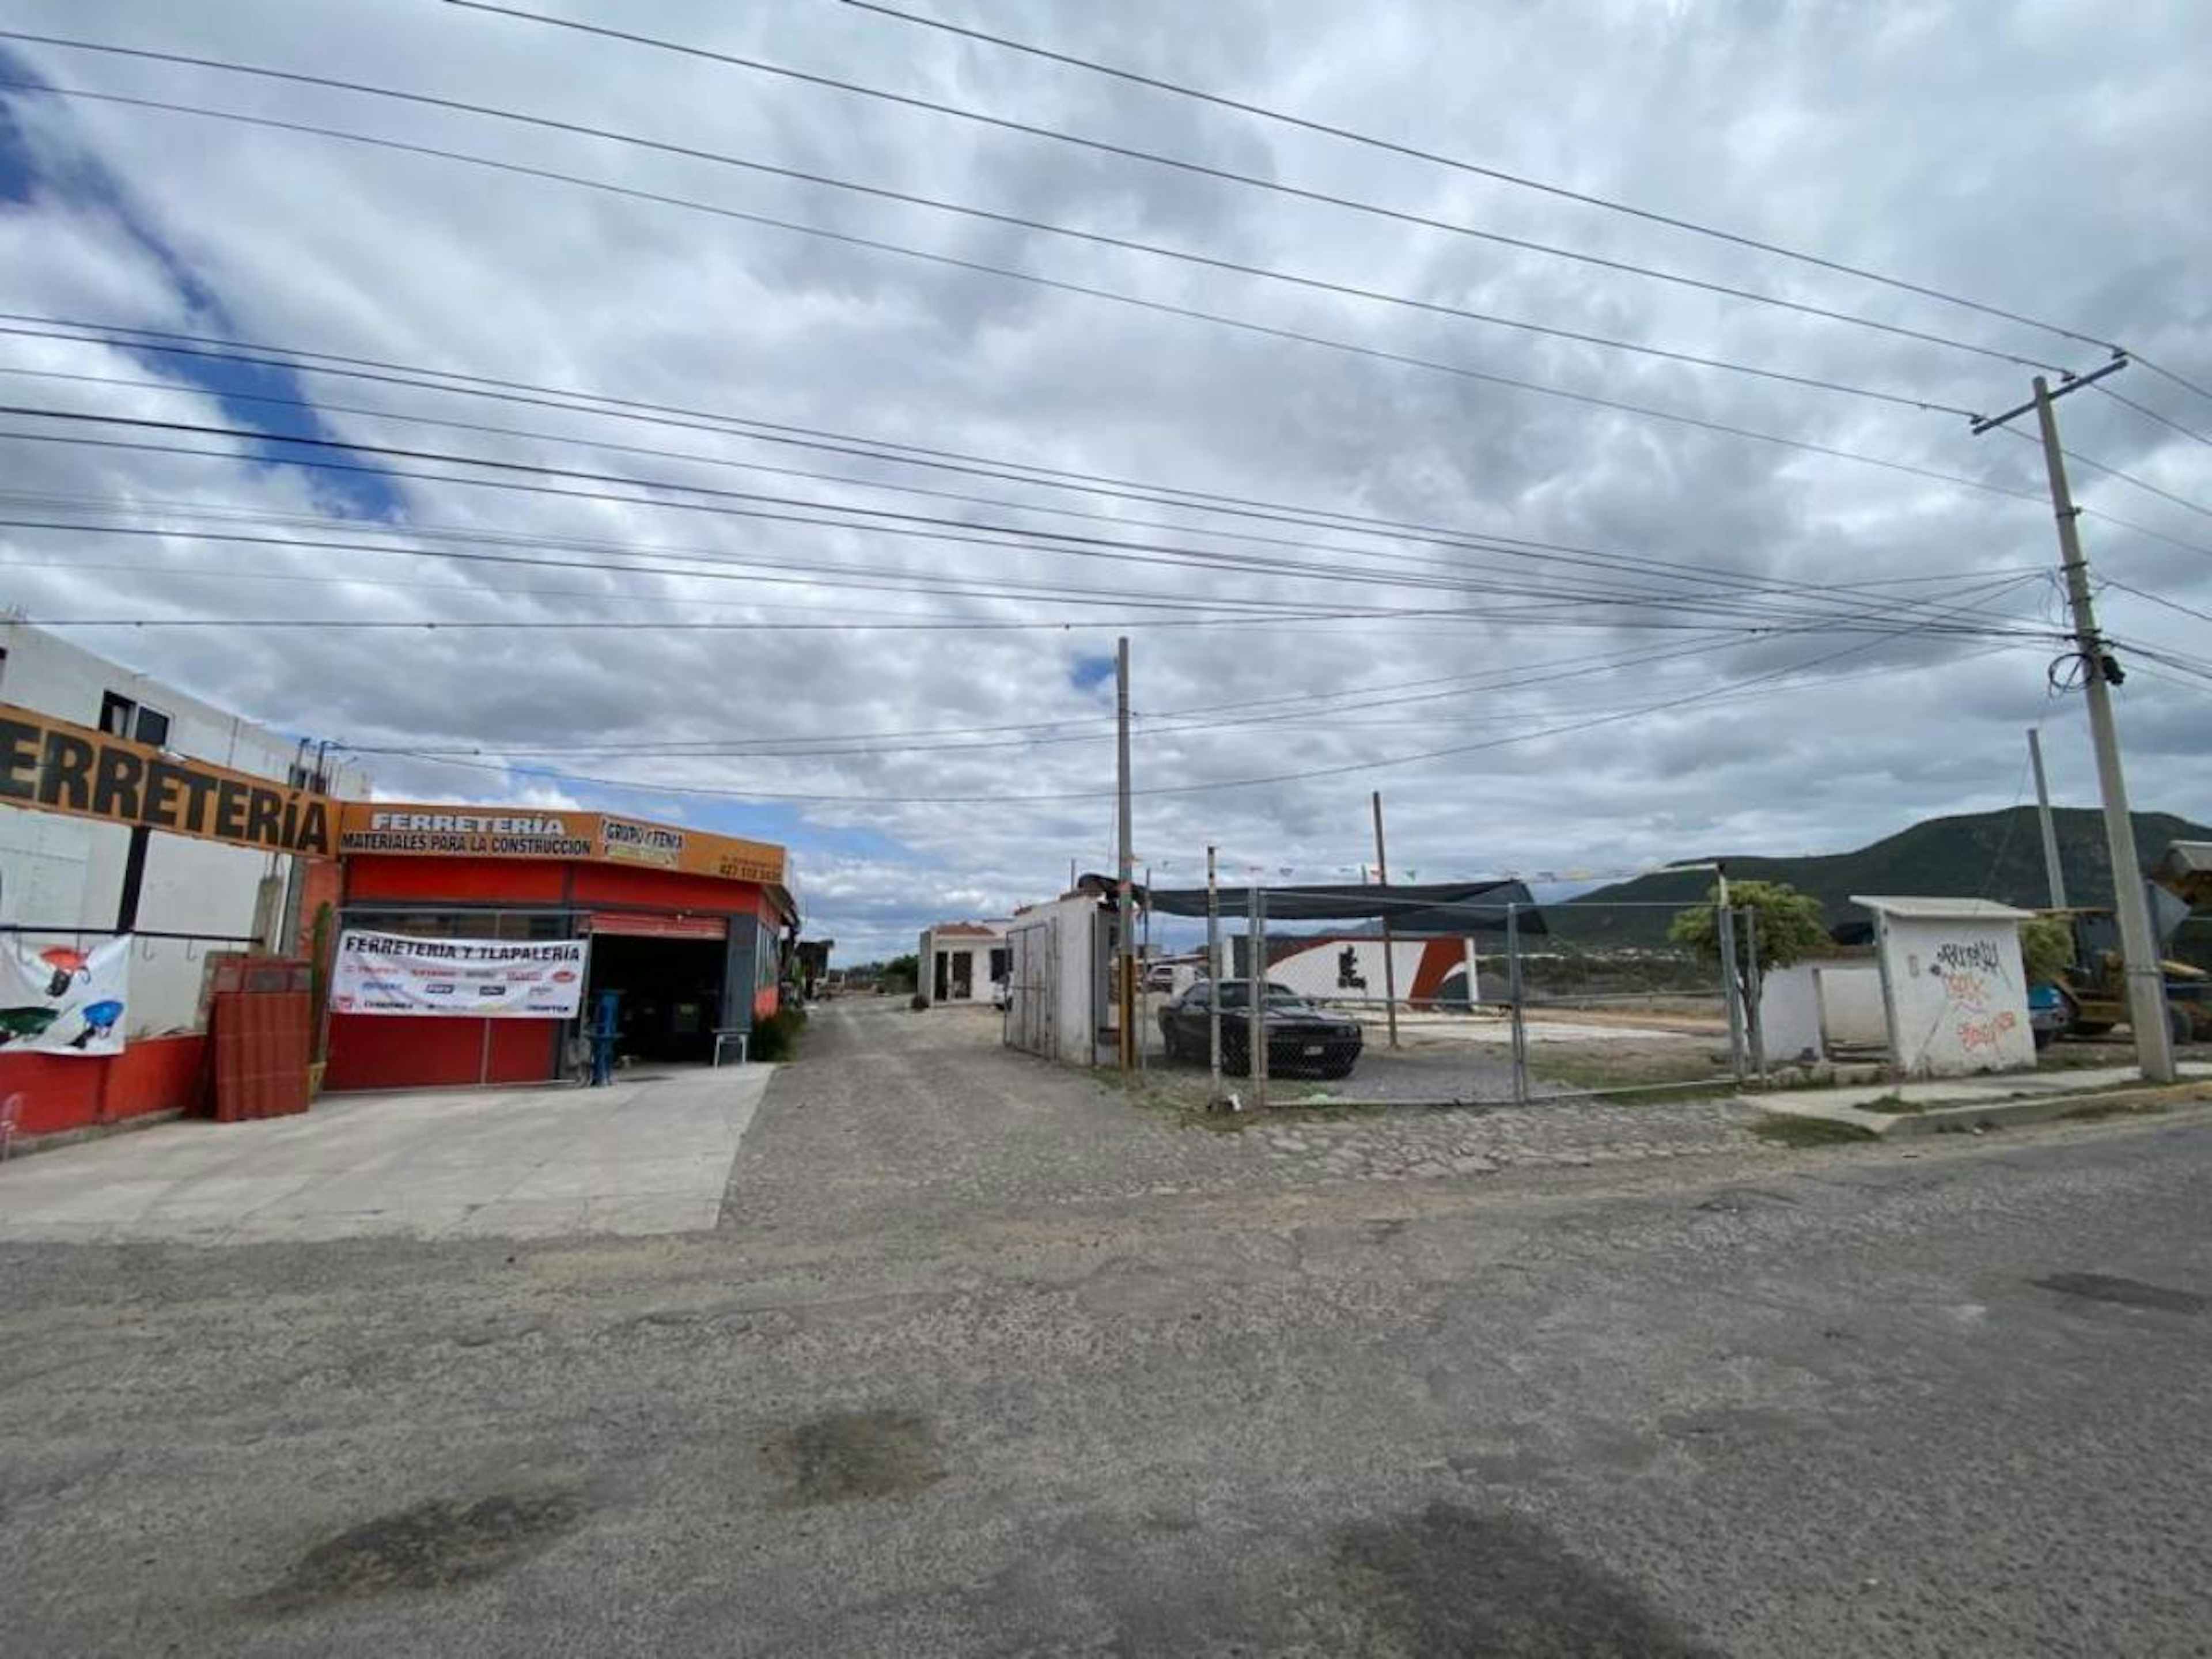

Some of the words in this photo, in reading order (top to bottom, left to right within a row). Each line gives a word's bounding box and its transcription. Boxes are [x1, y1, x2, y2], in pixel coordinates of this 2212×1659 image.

[340, 833, 427, 850] MATERIALES
[431, 835, 466, 851] PARA
[470, 837, 487, 852] LA
[462, 946, 473, 959] Y
